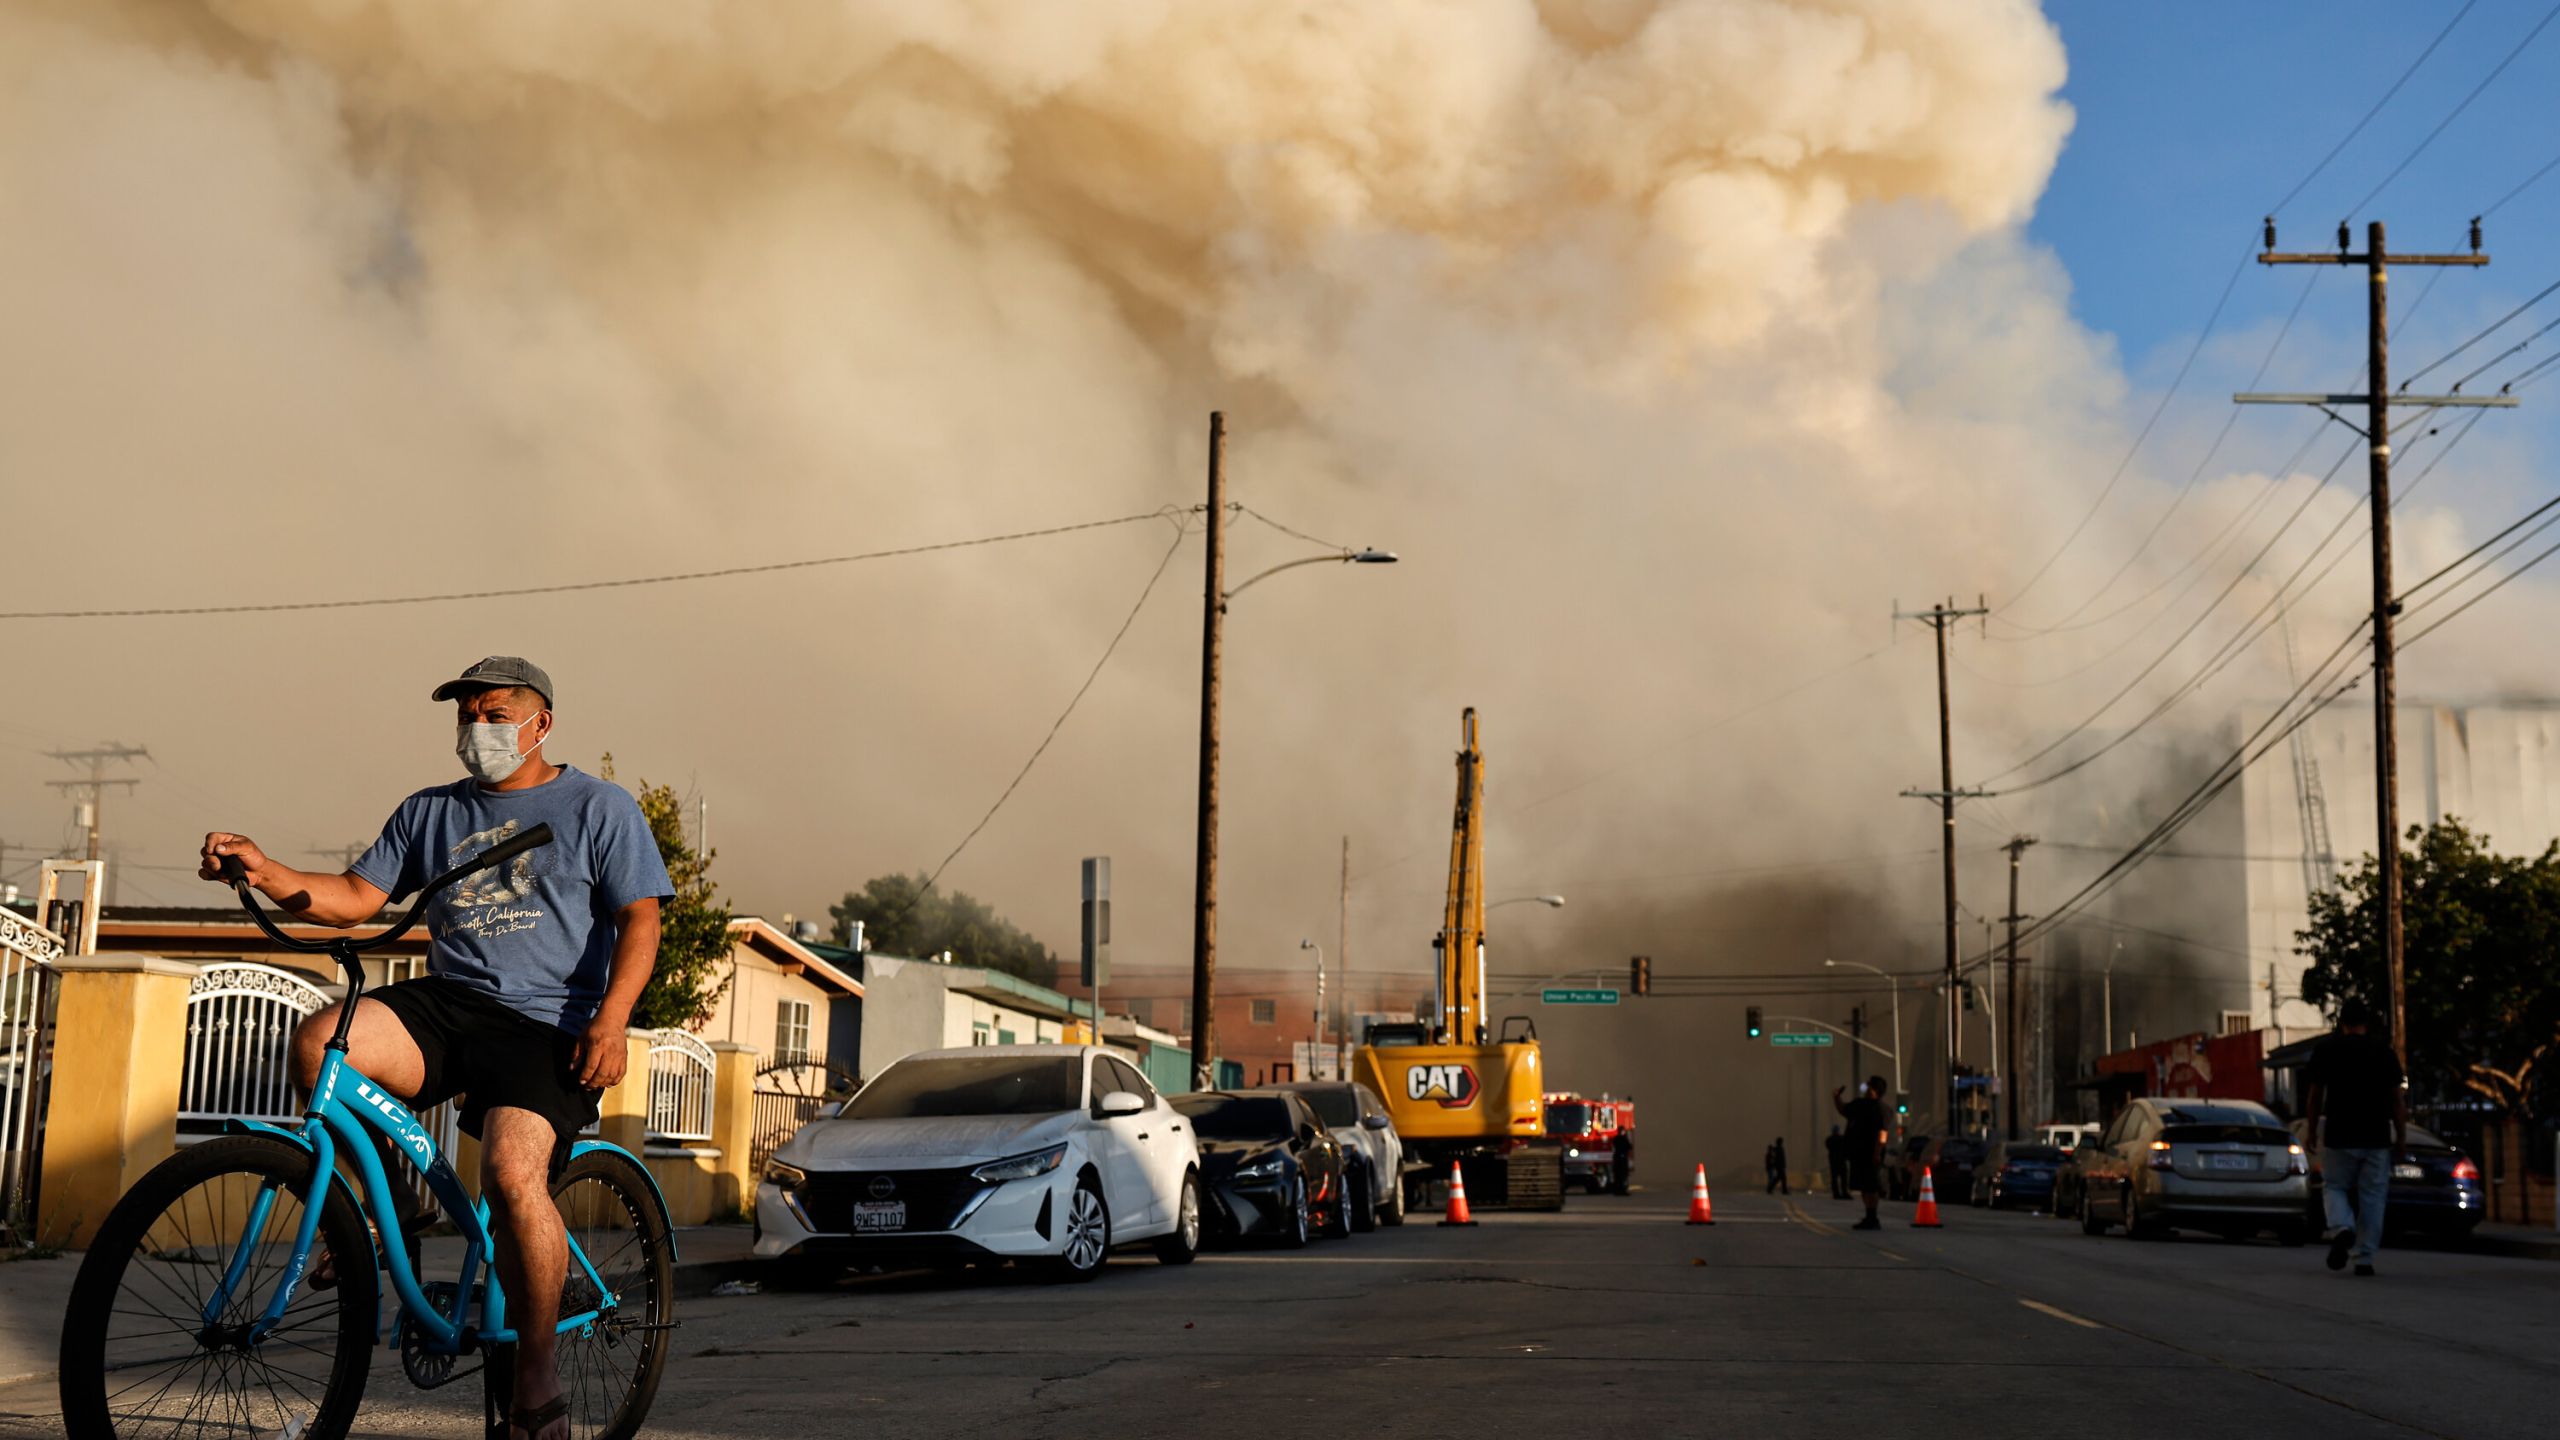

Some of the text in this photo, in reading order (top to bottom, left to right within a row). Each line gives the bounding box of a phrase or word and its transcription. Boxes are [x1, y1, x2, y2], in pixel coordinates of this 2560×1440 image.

[486, 906, 544, 924] California
[477, 928, 493, 938] They
[495, 925, 508, 936] Do
[1570, 992, 1596, 1001] Pacific
[1600, 993, 1615, 1001] Ave
[324, 1060, 340, 1101] UC
[1407, 1065, 1463, 1100] CAT
[356, 1081, 408, 1124] UC
[855, 1212, 904, 1227] 9WET107
